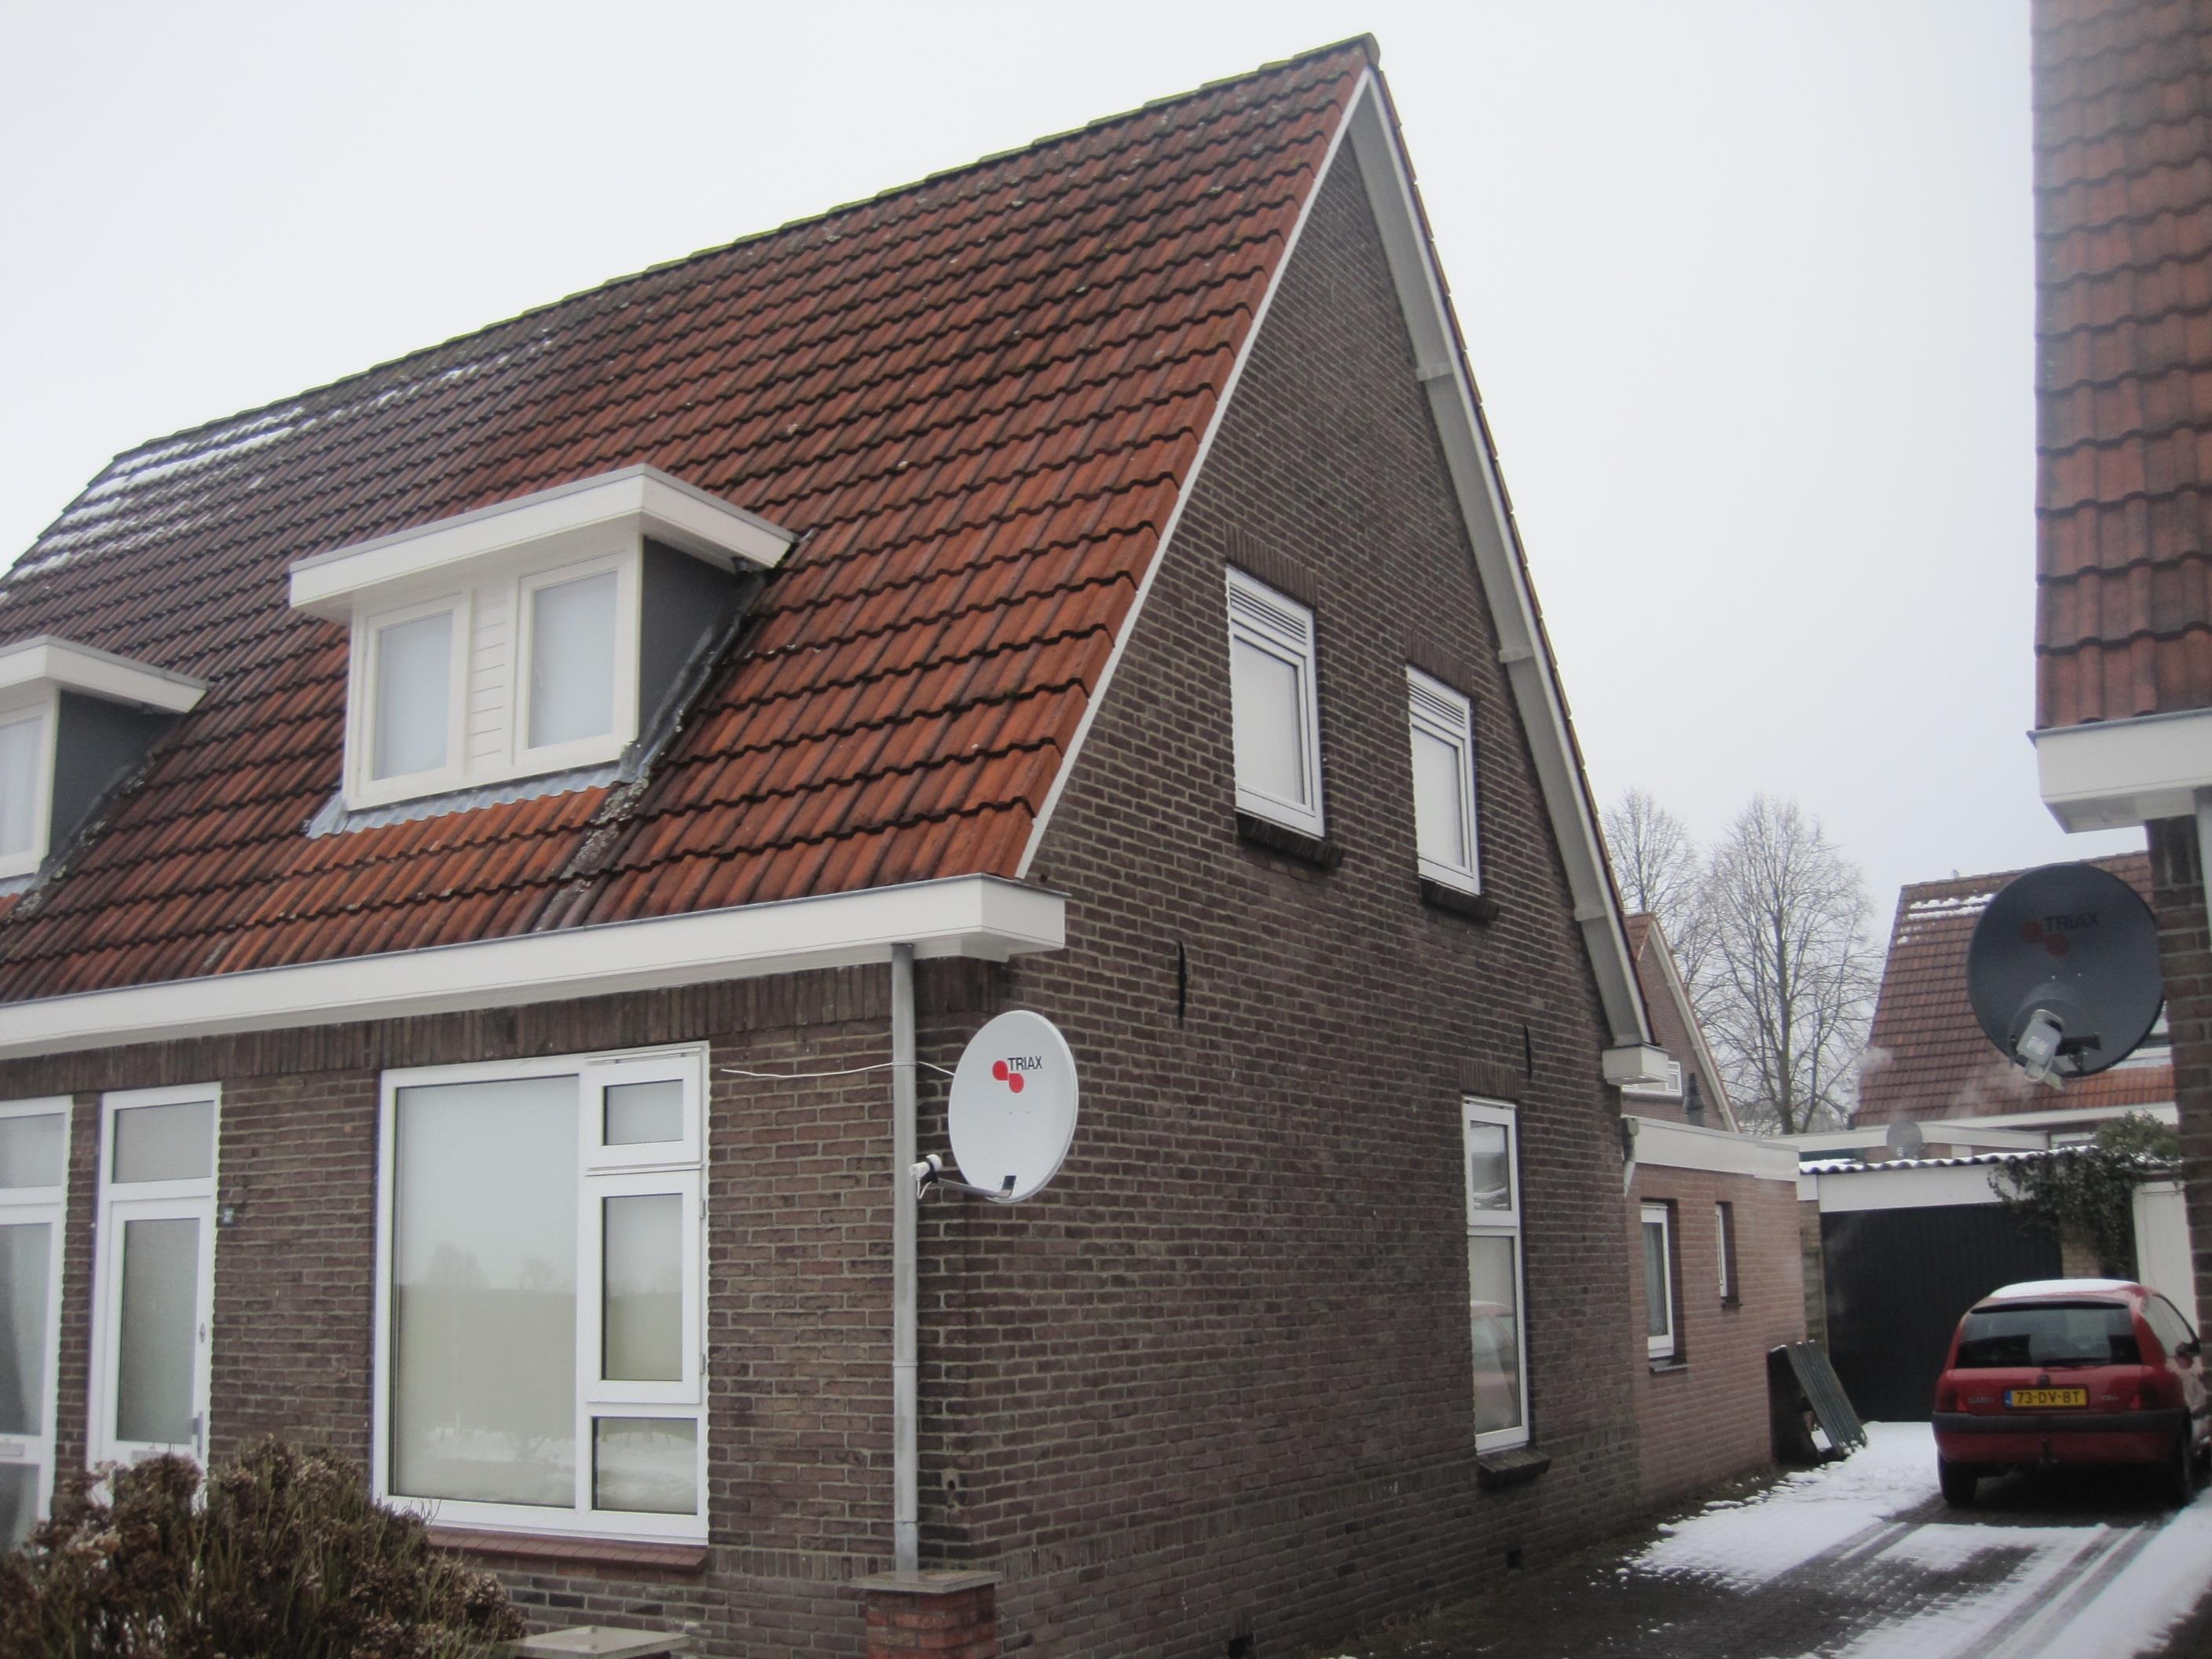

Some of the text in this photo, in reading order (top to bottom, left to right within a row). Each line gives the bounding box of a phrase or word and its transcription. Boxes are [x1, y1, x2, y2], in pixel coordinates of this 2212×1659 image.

[2044, 913, 2100, 931] TRIAX
[1007, 1056, 1042, 1071] TRIAX
[2016, 1391, 2079, 1404] 73-DV-BT
